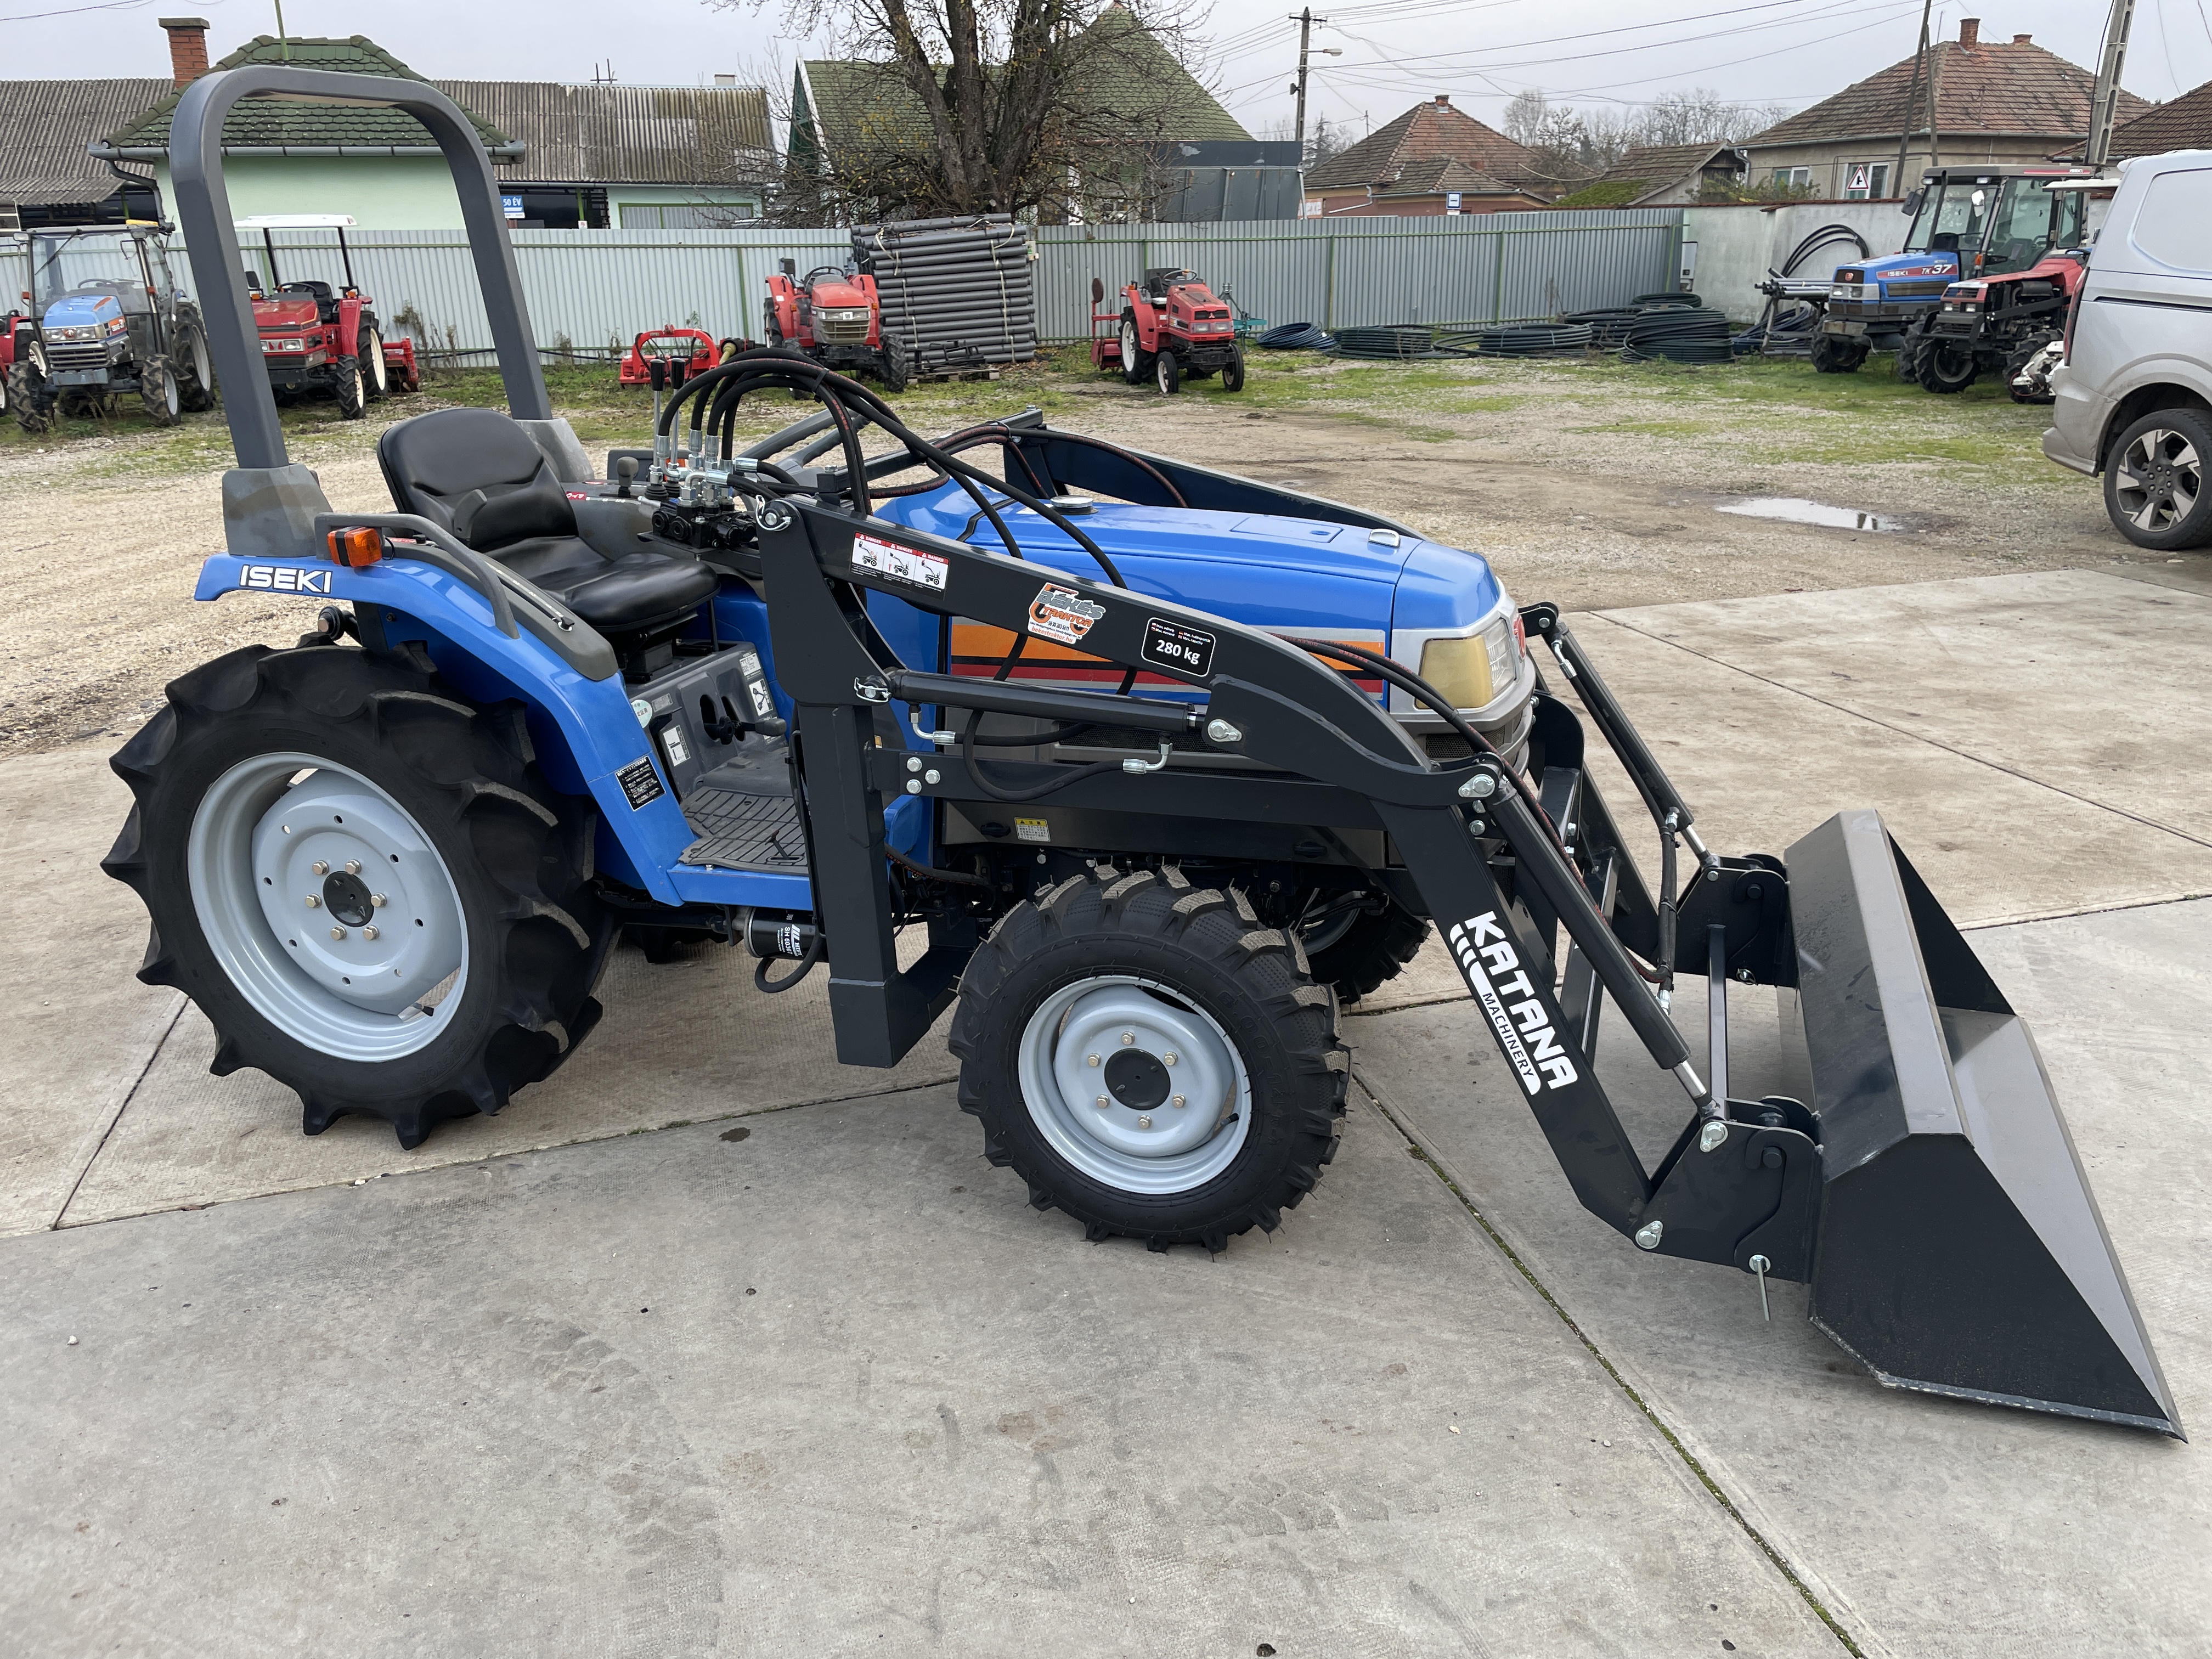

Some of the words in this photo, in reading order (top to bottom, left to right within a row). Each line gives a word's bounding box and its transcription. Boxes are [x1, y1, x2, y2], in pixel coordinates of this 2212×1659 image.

[512, 196, 521, 206] ÉV
[865, 536, 882, 545] DANGER
[896, 545, 913, 554] DANGER
[928, 554, 945, 563] DANGER
[239, 564, 333, 594] ISEKI
[1036, 589, 1105, 619] BÉKÉS
[1042, 606, 1093, 628] TRAKTOR
[1031, 625, 1074, 643] bekestraktor.hu
[1156, 639, 1182, 657] 280
[1183, 646, 1201, 665] kg
[784, 926, 791, 936] SH
[1464, 910, 1578, 1090] KATANA
[1482, 992, 1534, 1077] MACHINERY
